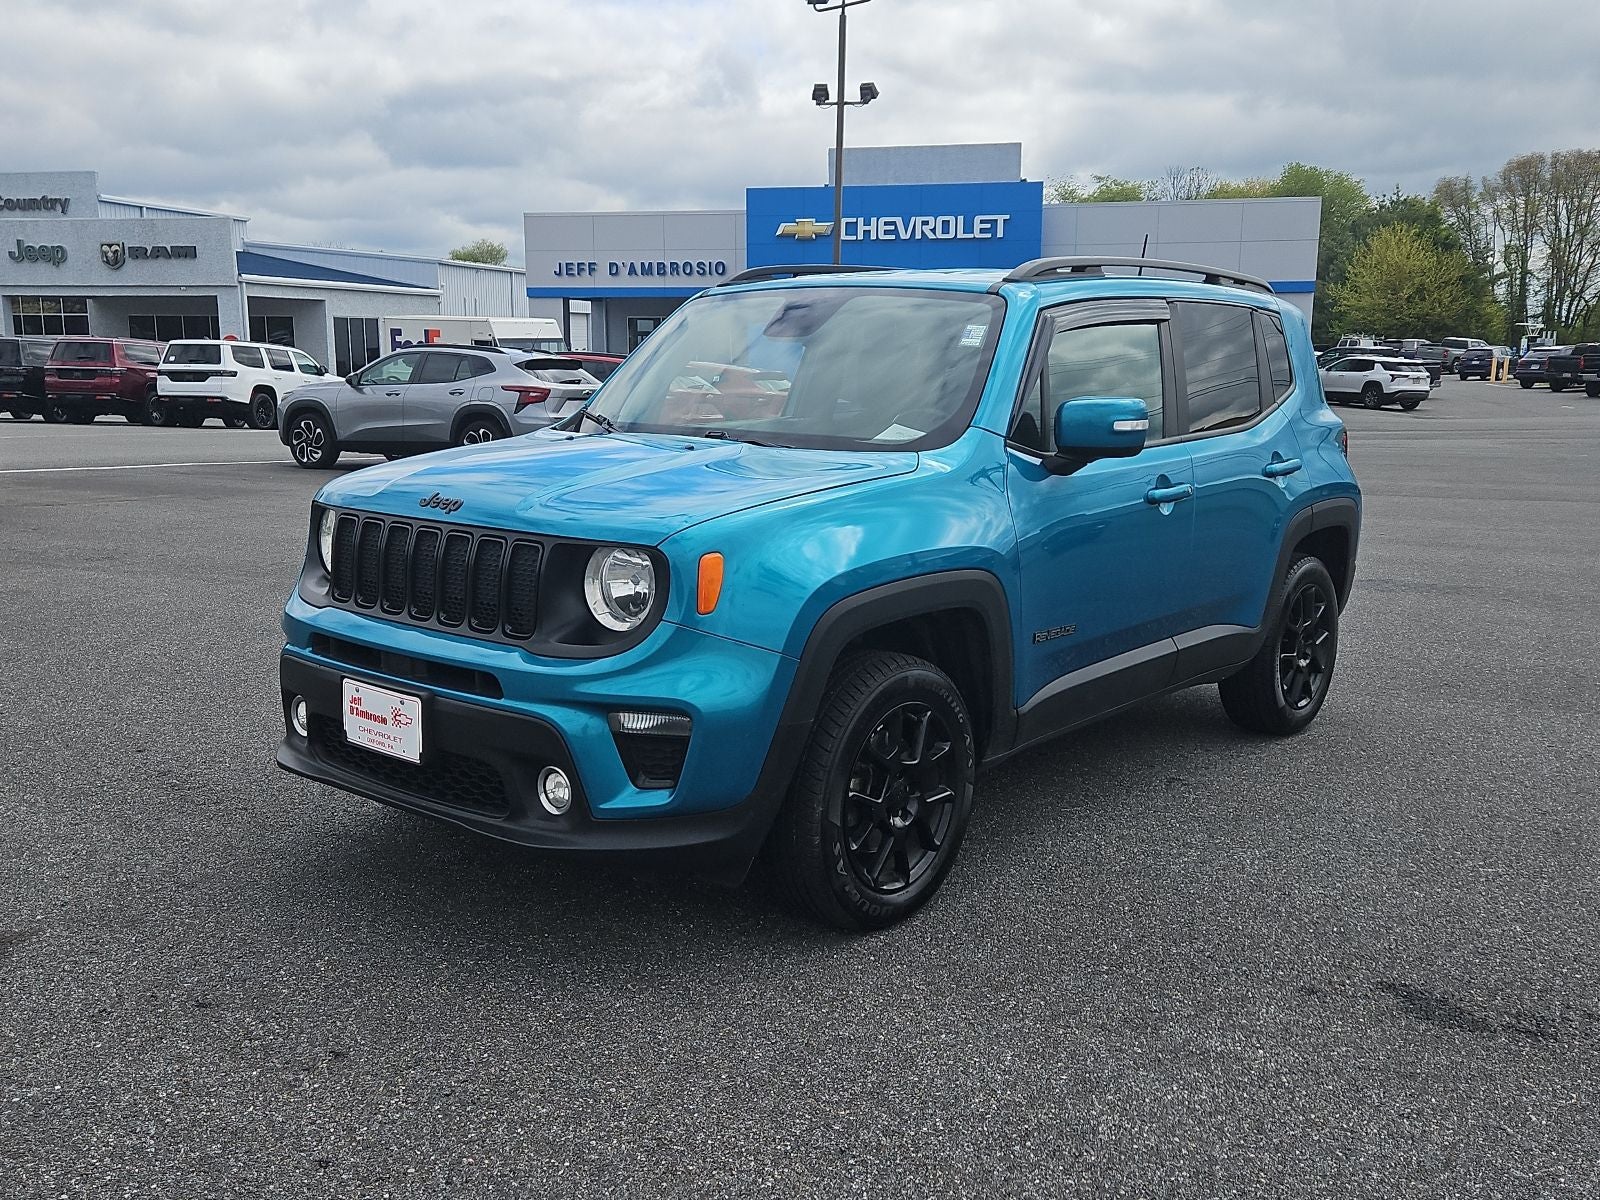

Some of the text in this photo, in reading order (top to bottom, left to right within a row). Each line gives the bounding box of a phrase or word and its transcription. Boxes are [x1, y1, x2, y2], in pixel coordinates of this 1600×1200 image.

[0, 195, 70, 215] ountry
[841, 214, 1010, 240] CHEVROLET
[8, 238, 68, 267] Jeep
[128, 245, 197, 260] RAM
[553, 261, 727, 277] JEFF D'AMBROSIO
[419, 491, 464, 515] Jeep
[349, 695, 362, 706] Jeff
[349, 705, 388, 726] D'Ambrosio
[358, 725, 403, 744] CHEVROLET
